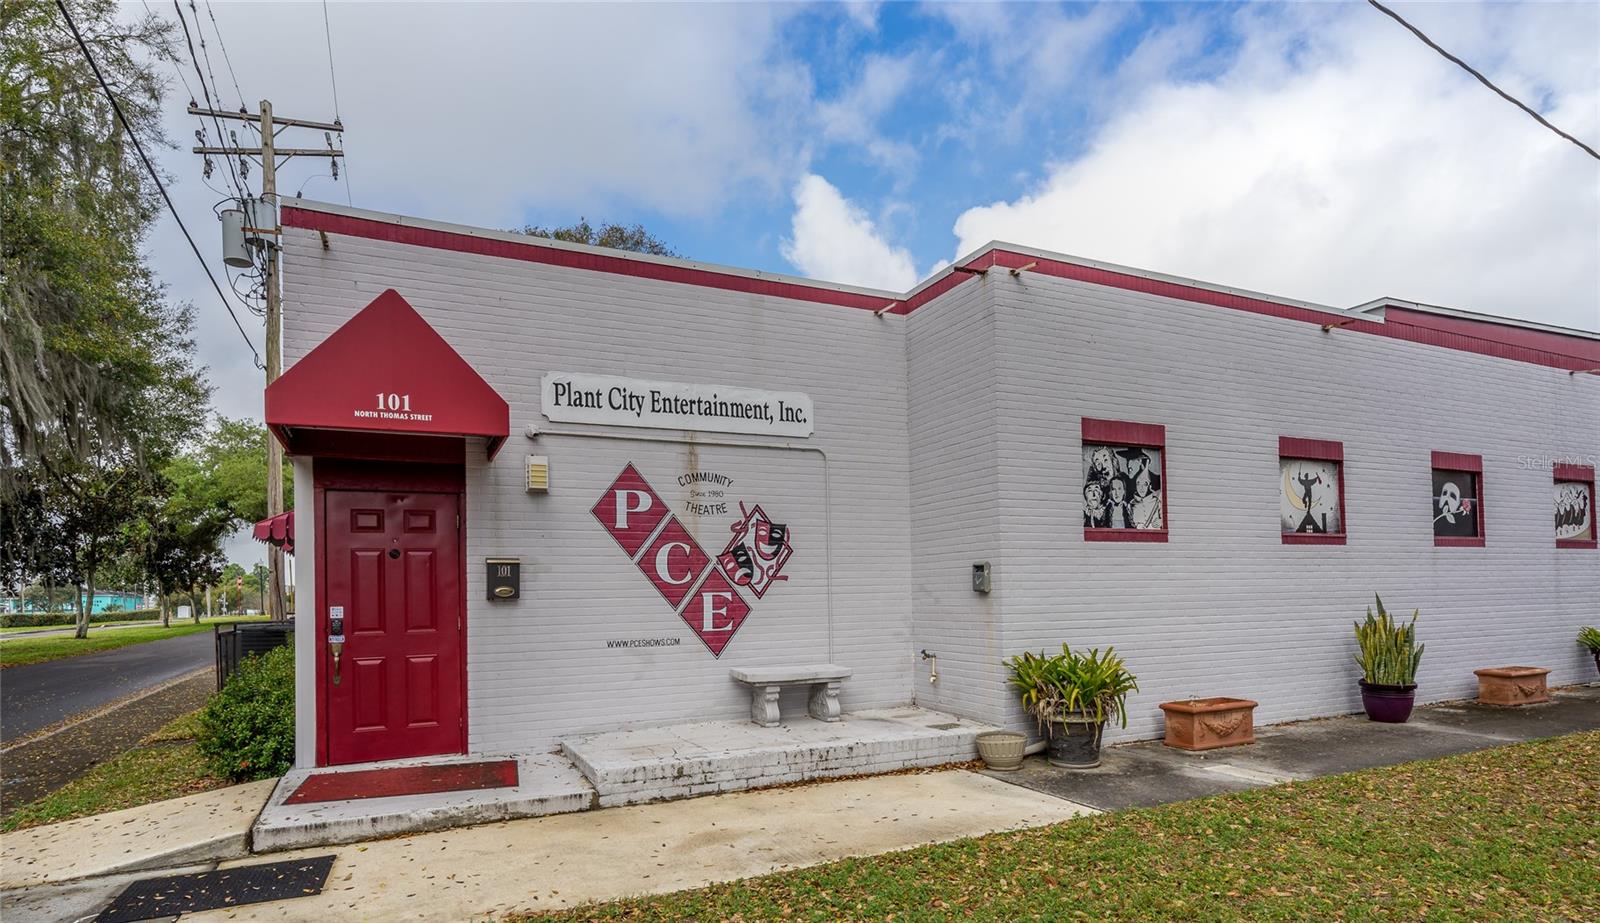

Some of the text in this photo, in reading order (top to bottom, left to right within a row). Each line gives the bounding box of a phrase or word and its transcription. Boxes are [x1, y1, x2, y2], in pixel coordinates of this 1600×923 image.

[376, 392, 411, 411] 101
[553, 381, 807, 424] Plant City Entertainment, Inc.
[354, 410, 432, 421] NORTH THOMAS STREET
[677, 472, 734, 487] COMMUNITY
[708, 490, 724, 498] 1980
[685, 501, 728, 515] THEATRE
[497, 565, 511, 577] 101
[606, 638, 680, 648] WWW.PCESHOWS.COM
